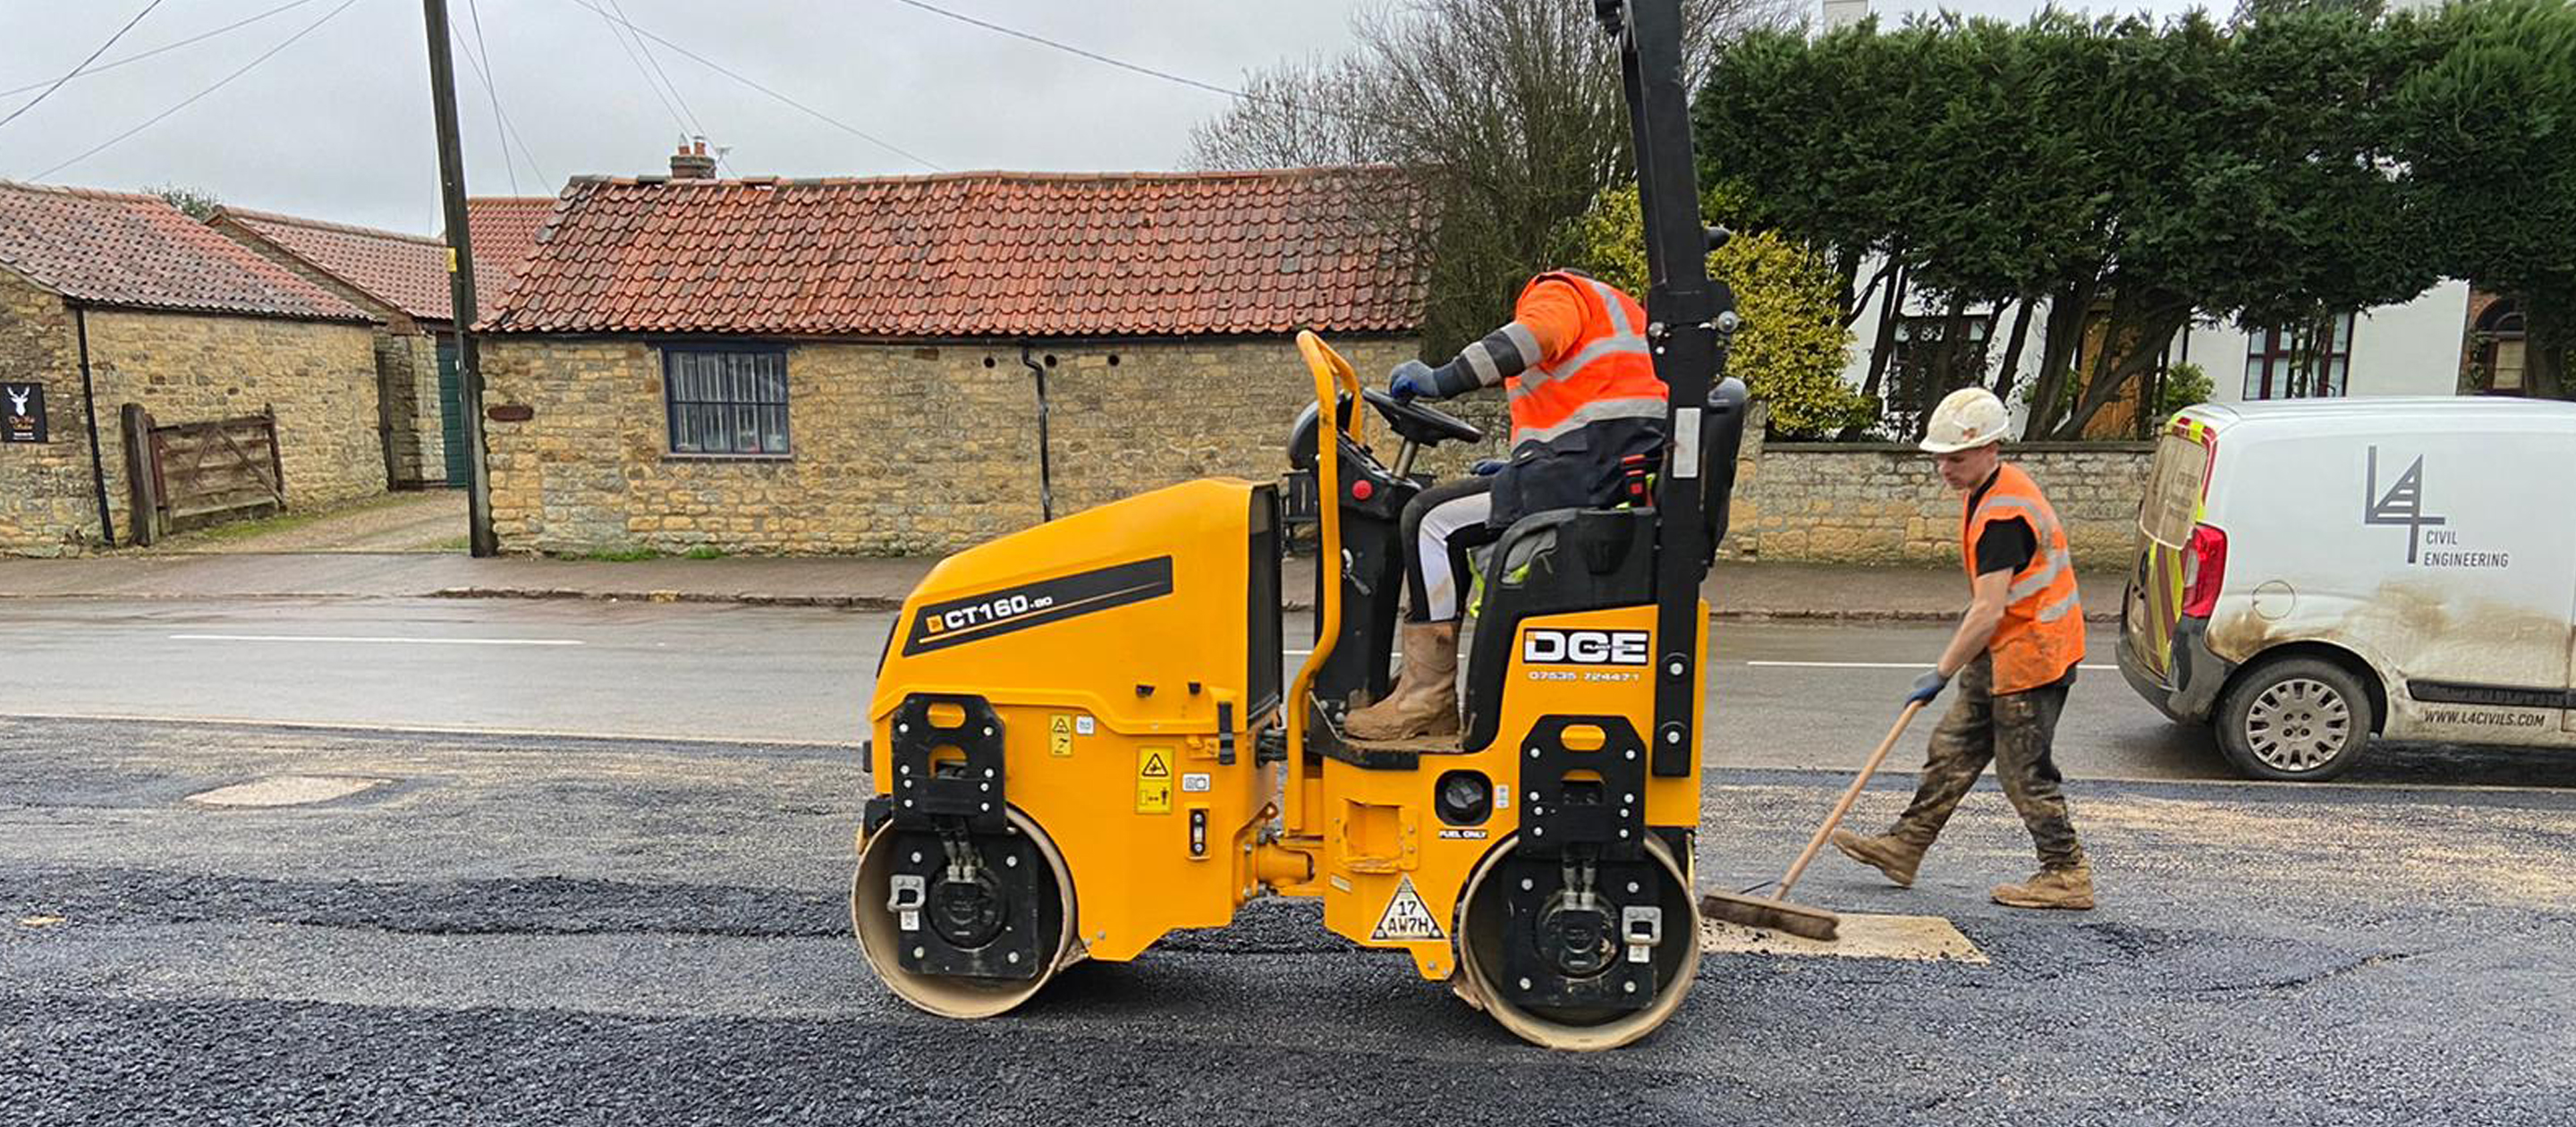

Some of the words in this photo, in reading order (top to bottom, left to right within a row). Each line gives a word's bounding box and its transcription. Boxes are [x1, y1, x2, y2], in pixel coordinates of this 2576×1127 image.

[2426, 530, 2458, 545] CIVIL
[2424, 551, 2509, 567] ENGINEERING
[1524, 631, 1648, 663] DCE
[2424, 709, 2546, 727] WWW.L4CIVILS.COM
[1438, 830, 1462, 838] FUEL
[1462, 830, 1487, 838] ONLY
[1398, 901, 1417, 916] 17
